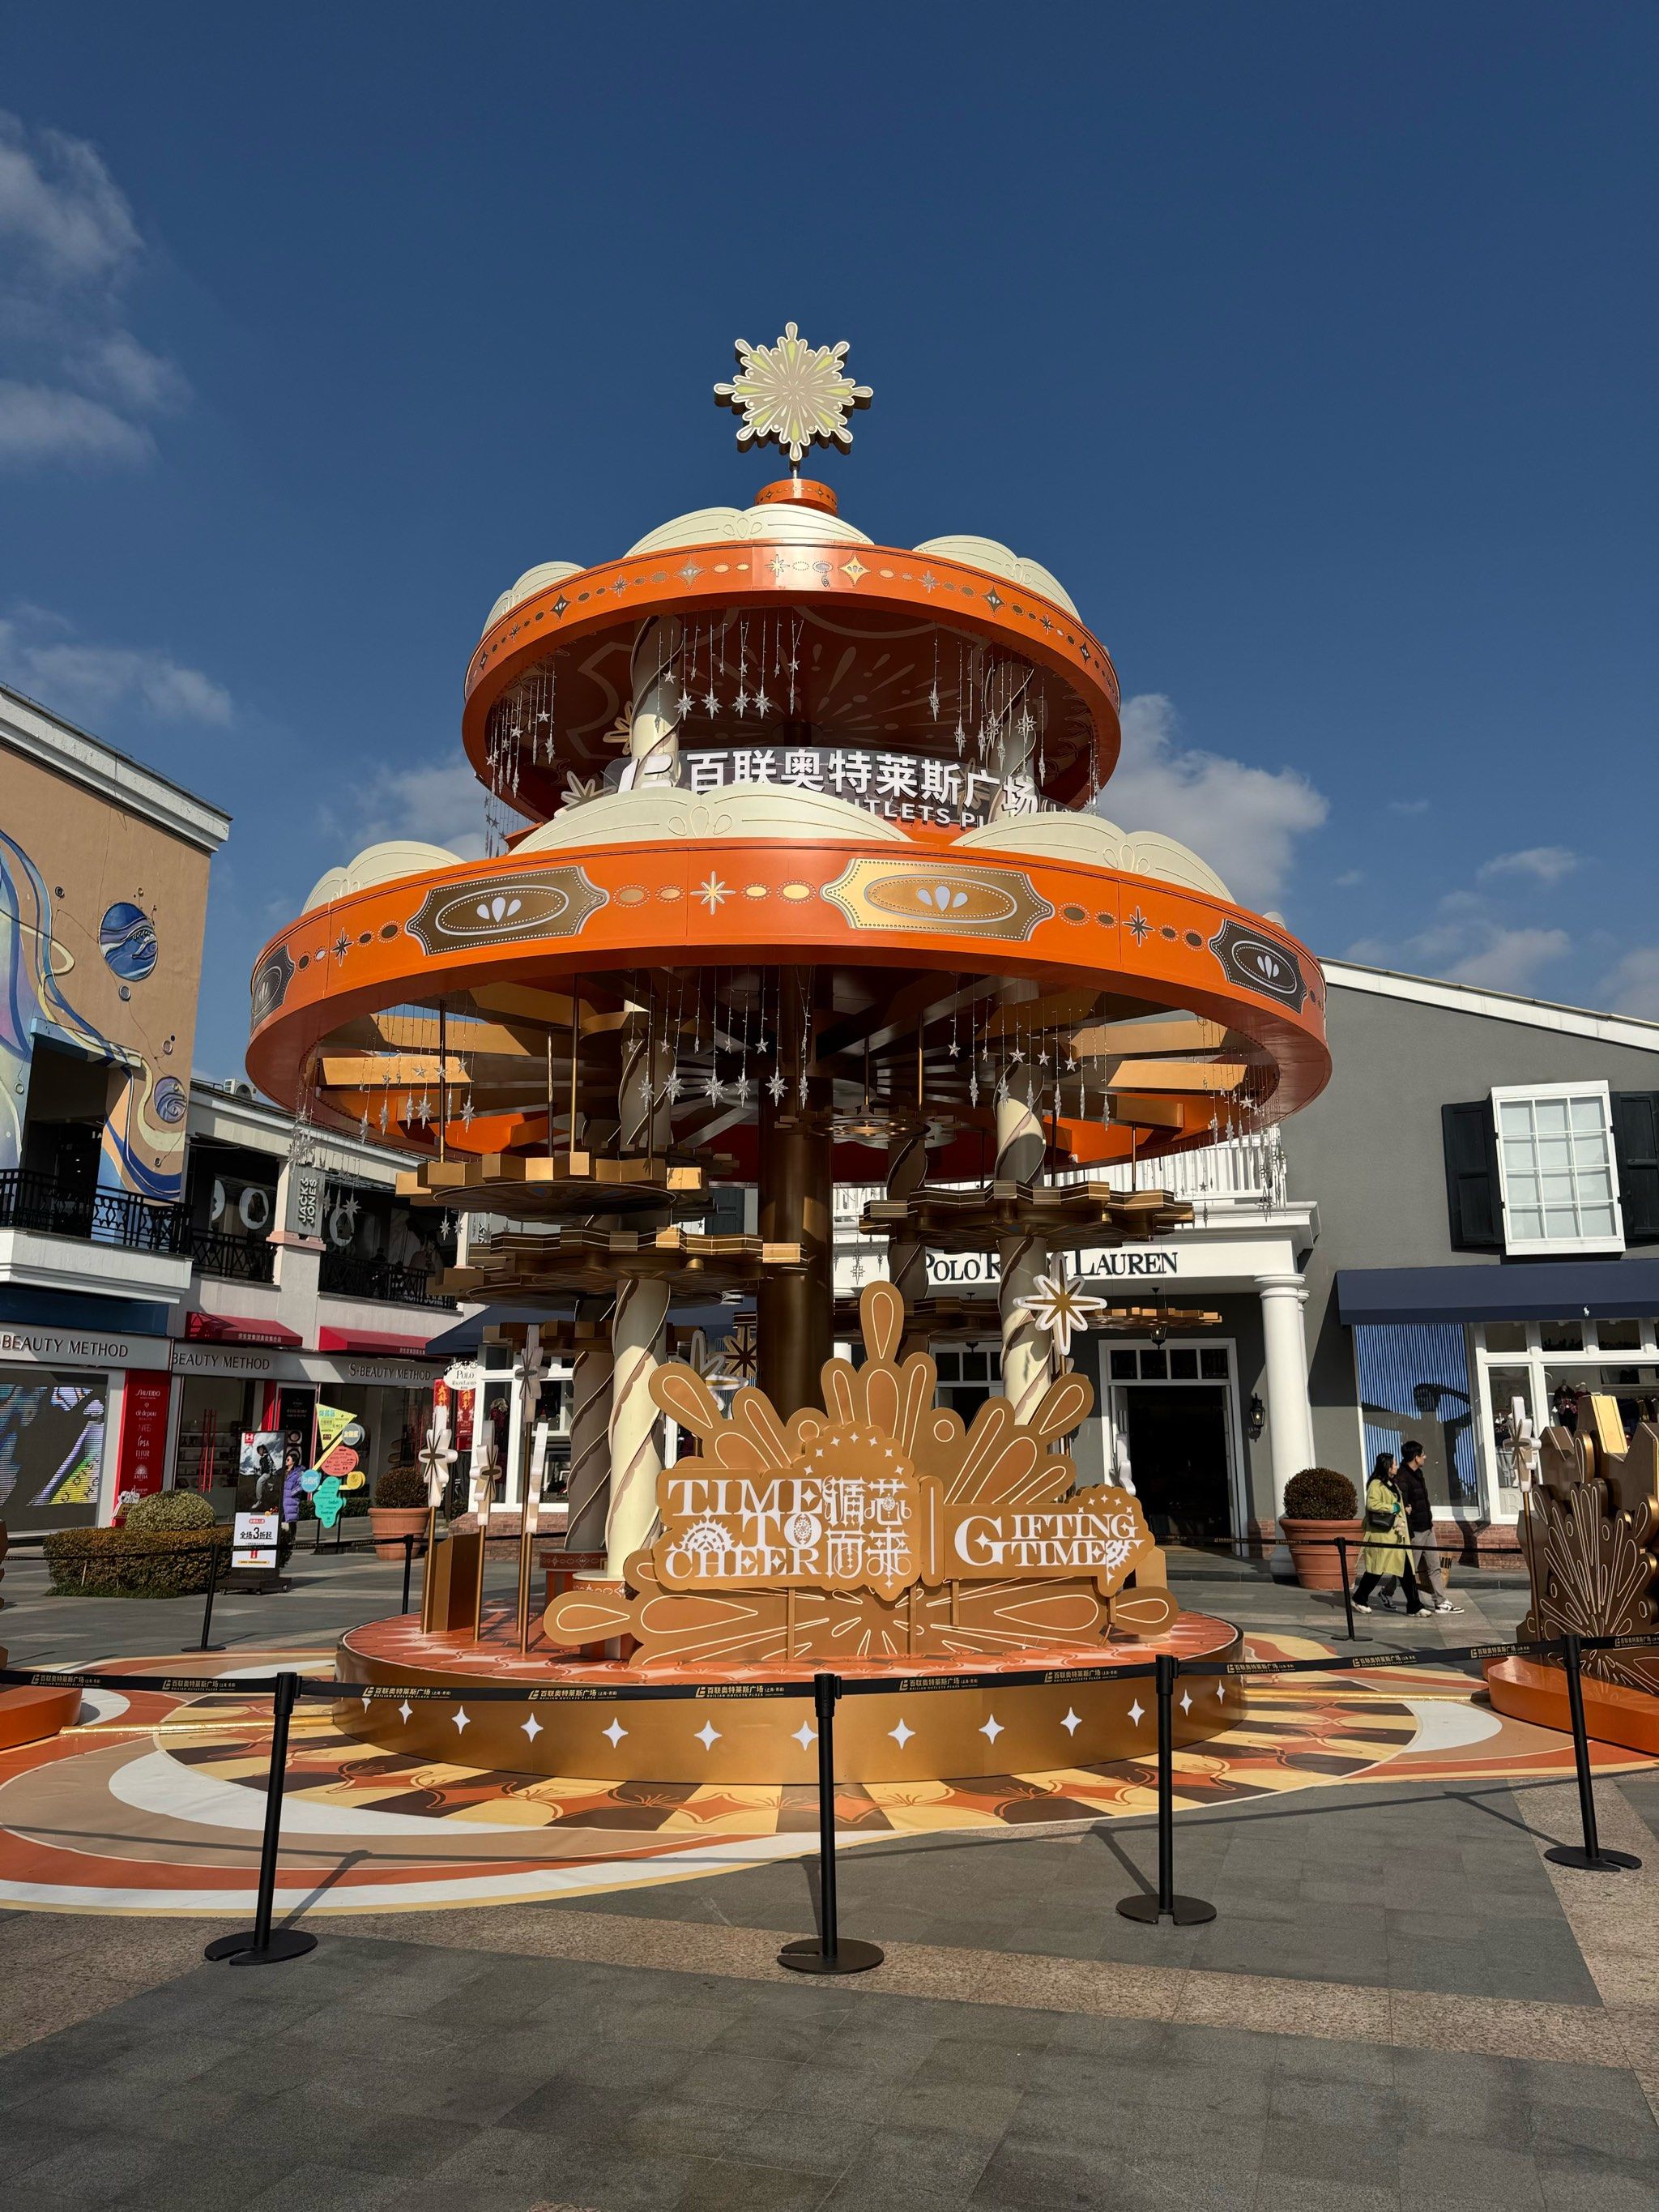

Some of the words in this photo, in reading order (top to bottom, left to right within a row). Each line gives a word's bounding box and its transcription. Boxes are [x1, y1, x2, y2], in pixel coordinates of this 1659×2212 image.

[686, 749, 1039, 816] 百联奥特莱斯广场
[307, 1179, 318, 1223] JONES
[1074, 1249, 1178, 1277] LAUREN
[2, 1335, 63, 1352] BEAUTY
[68, 1340, 128, 1357] METHOD
[173, 1352, 218, 1367] BEAUTY
[223, 1356, 270, 1370] METHOD
[348, 1363, 394, 1378] S-BEAUTY
[396, 1369, 431, 1381] METHOD
[135, 1389, 160, 1397] SHISEIDO
[667, 1479, 822, 1517] TIME
[240, 1527, 273, 1539] 全场3折起
[741, 1512, 822, 1549] TO
[665, 1545, 822, 1578] CHEER
[1011, 1539, 1107, 1567] TIME
[41, 1675, 84, 1684] 百联奥特莱斯广场
[909, 1677, 960, 1687] 百联奥特莱斯广场
[1054, 1669, 1101, 1679] 百联奥特莱斯广场
[172, 1680, 218, 1688] 百联奥特莱斯广场
[375, 1687, 431, 1695] 百联奥特莱斯广场
[706, 1685, 764, 1694] 百联奥特莱斯广场
